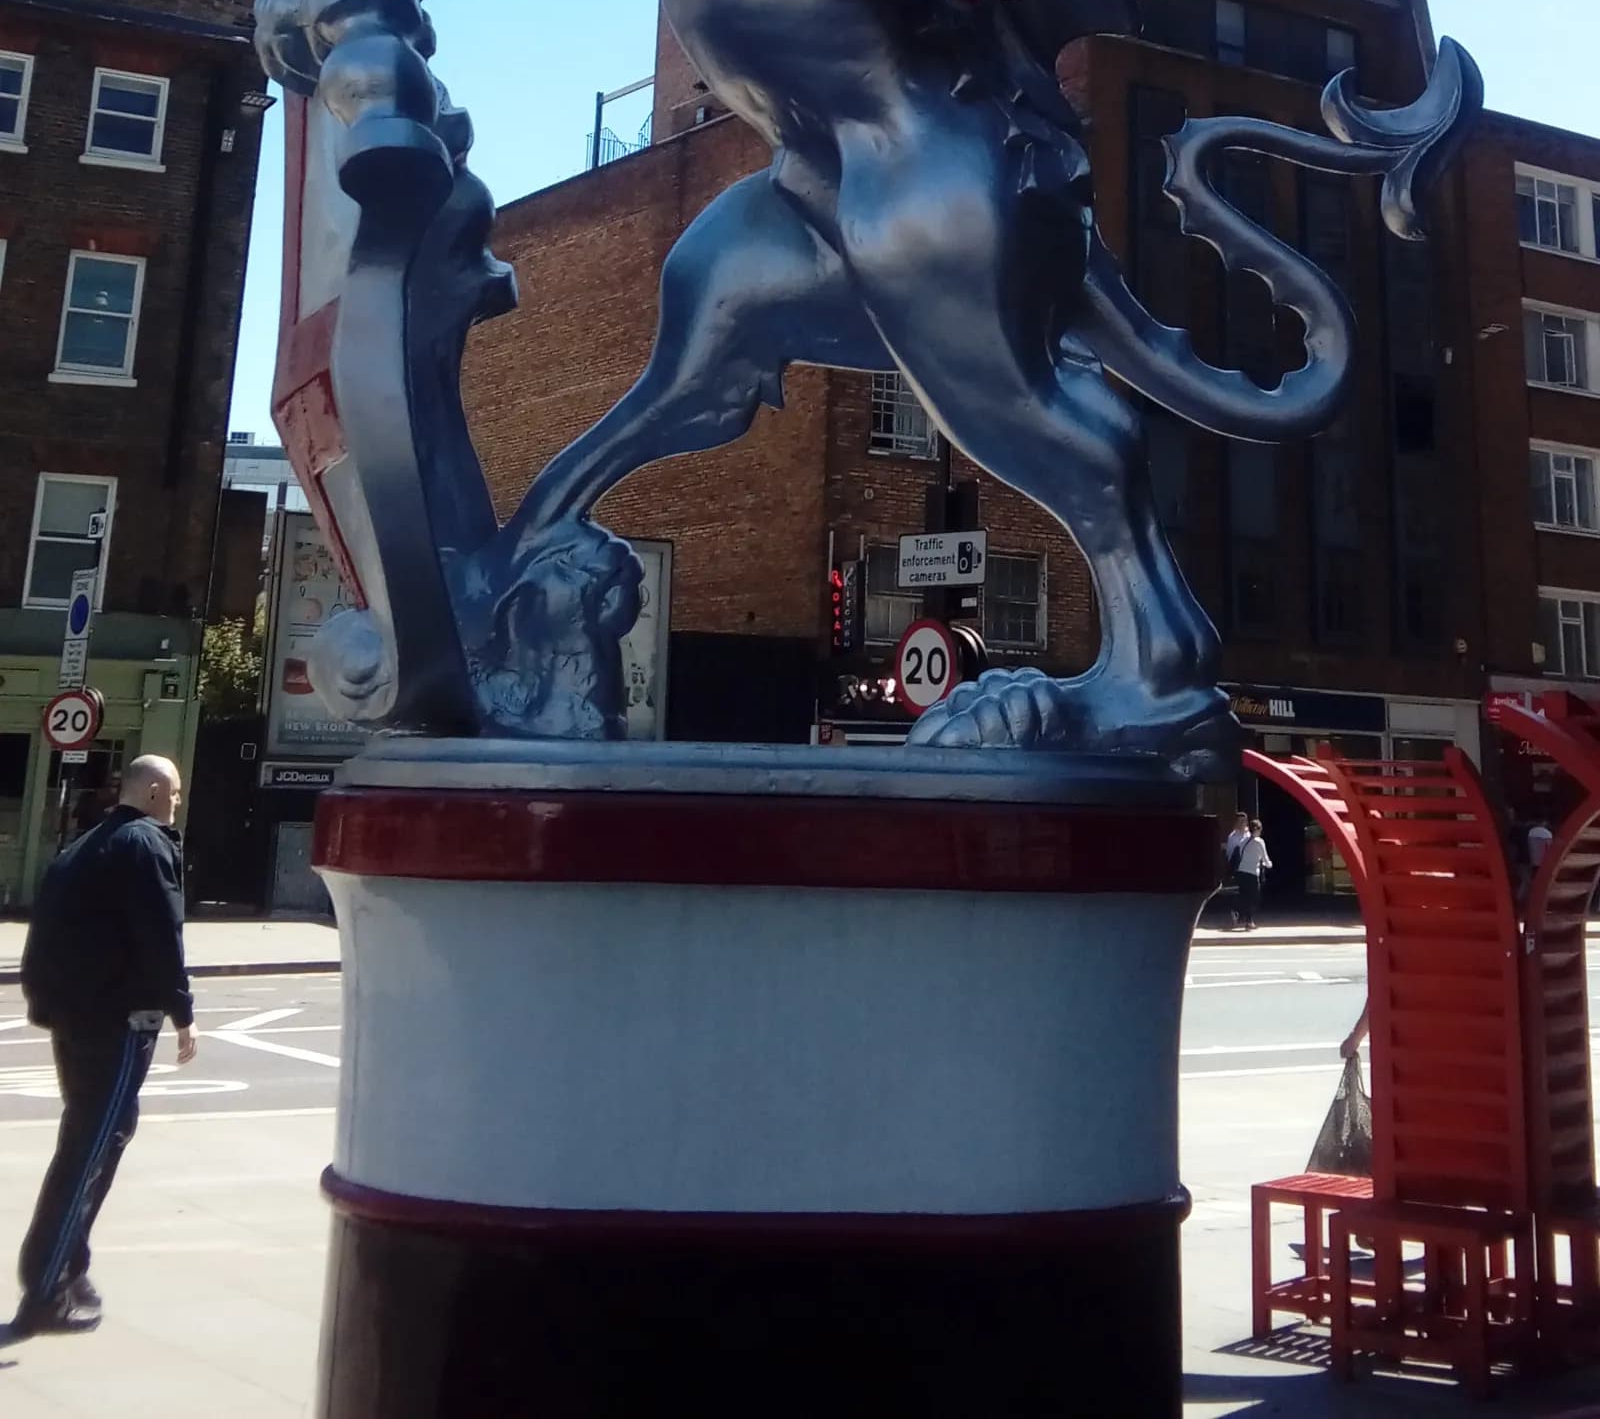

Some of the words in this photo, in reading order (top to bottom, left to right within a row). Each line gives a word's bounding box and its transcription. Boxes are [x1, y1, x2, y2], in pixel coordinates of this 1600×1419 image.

[914, 538, 944, 551] Traffic
[902, 553, 956, 567] enforcement
[909, 571, 947, 582] cameras
[831, 569, 843, 646] ROYAL
[905, 647, 947, 685] 20
[1269, 698, 1296, 718] HILL
[52, 709, 89, 732] 20
[284, 721, 311, 732] NEW
[275, 770, 331, 783] JCDecaux
